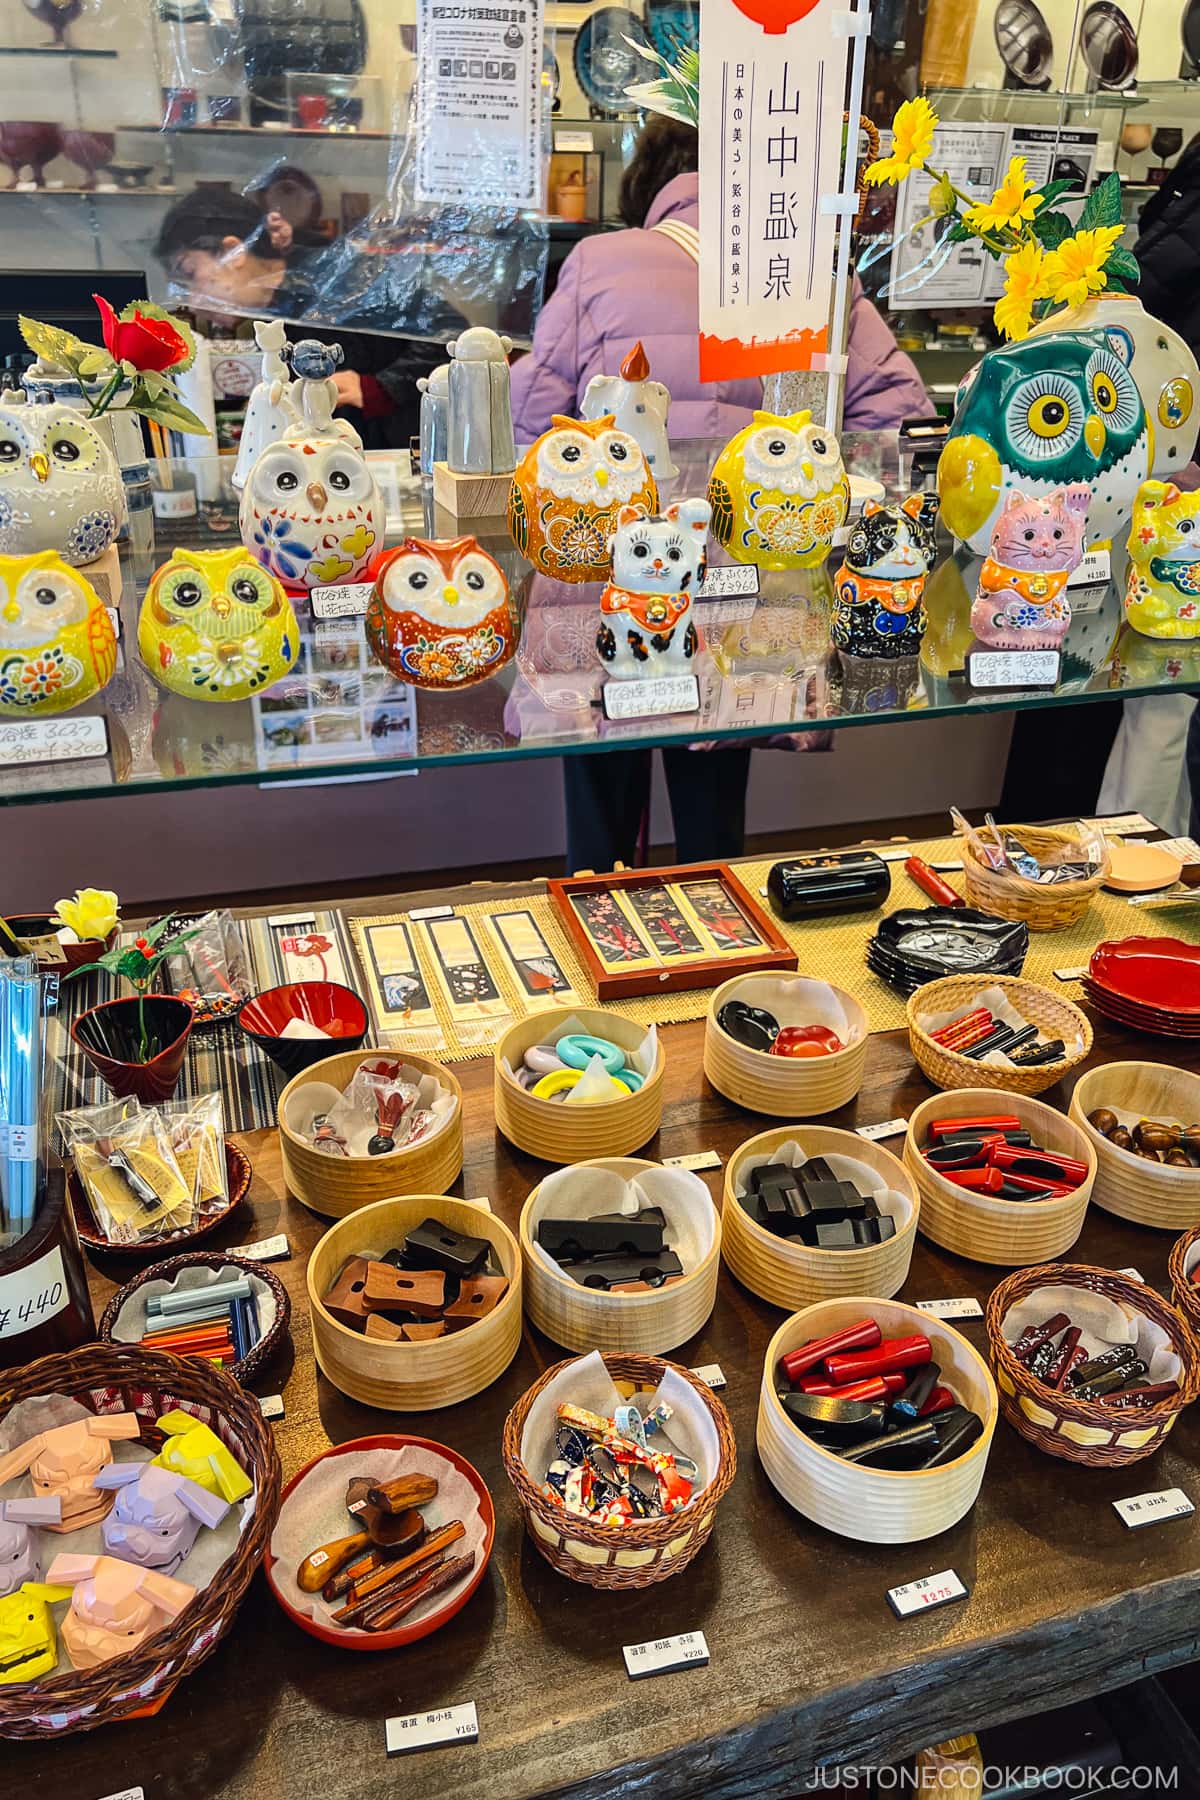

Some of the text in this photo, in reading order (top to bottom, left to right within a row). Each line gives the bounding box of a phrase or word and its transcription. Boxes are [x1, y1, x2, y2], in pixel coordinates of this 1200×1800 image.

[921, 1586, 953, 1604] ¥275
[653, 1639, 672, 1651] 和紙
[683, 1648, 704, 1659] ¥220
[455, 1723, 477, 1735] ¥165
